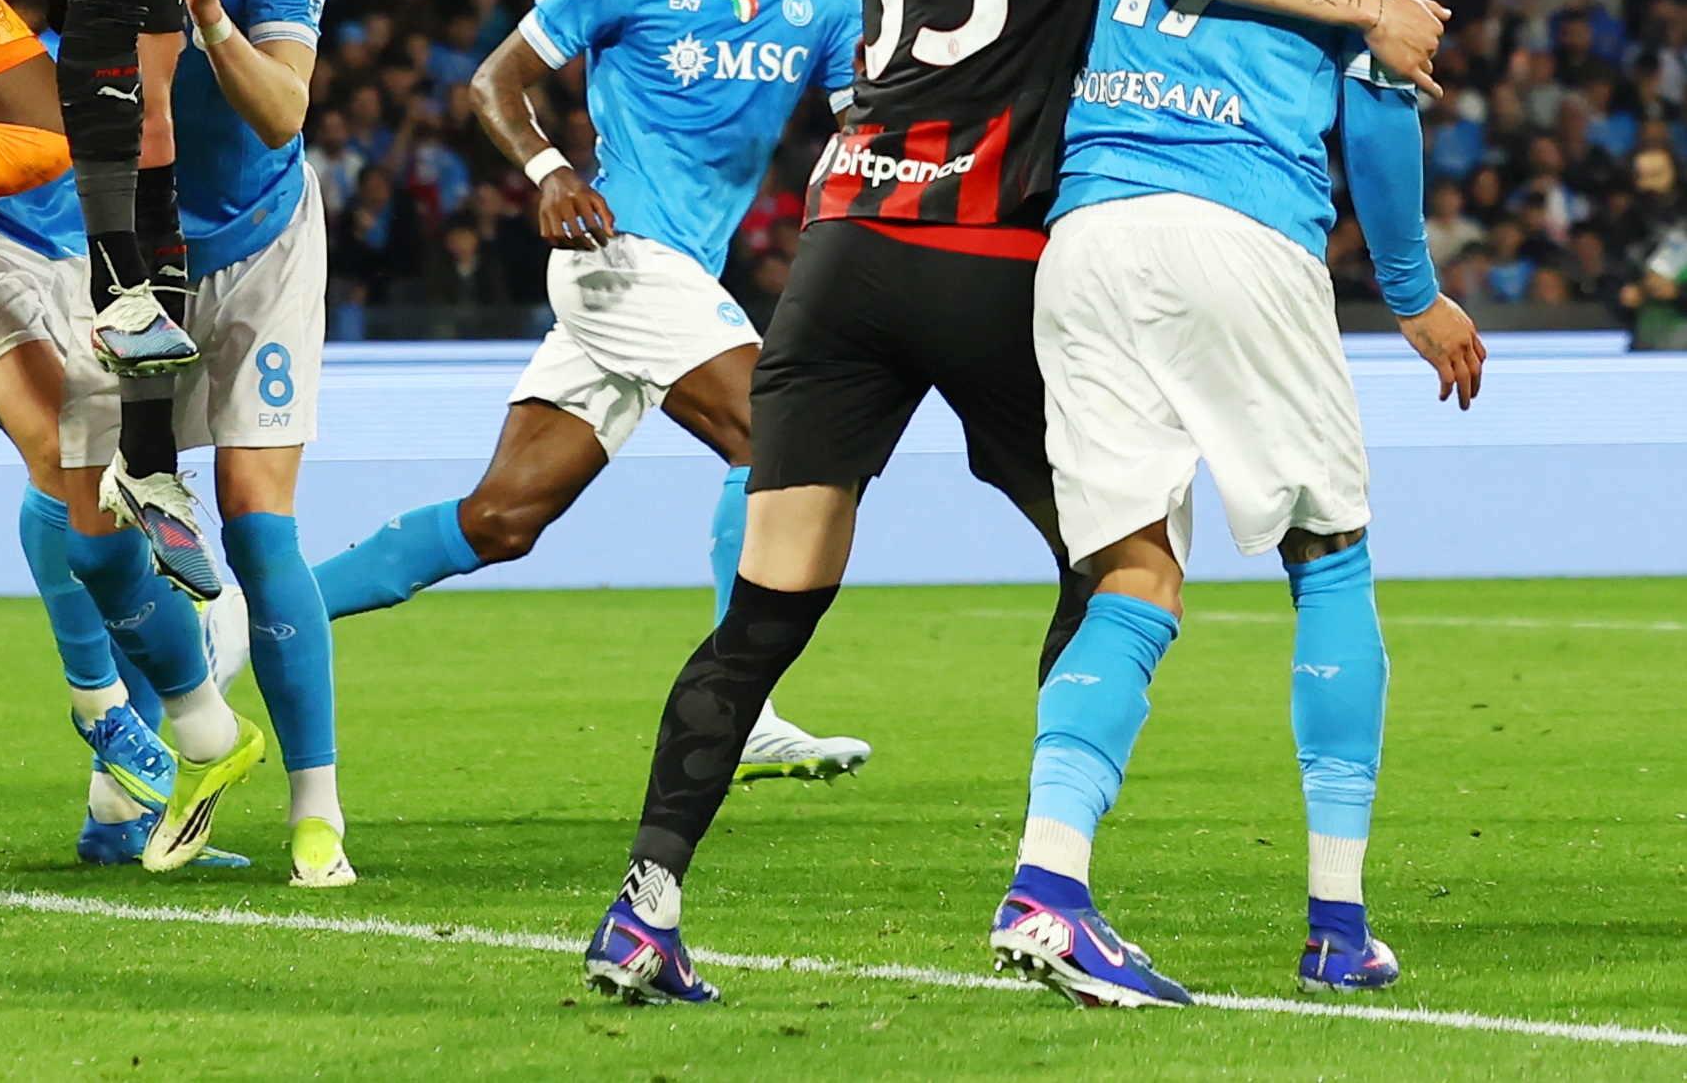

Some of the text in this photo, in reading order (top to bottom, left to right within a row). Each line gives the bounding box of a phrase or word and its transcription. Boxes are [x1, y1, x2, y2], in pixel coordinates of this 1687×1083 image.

[713, 40, 809, 85] MSC
[831, 142, 976, 188] bitpanda
[255, 341, 294, 408] 8
[258, 412, 292, 428] EA7
